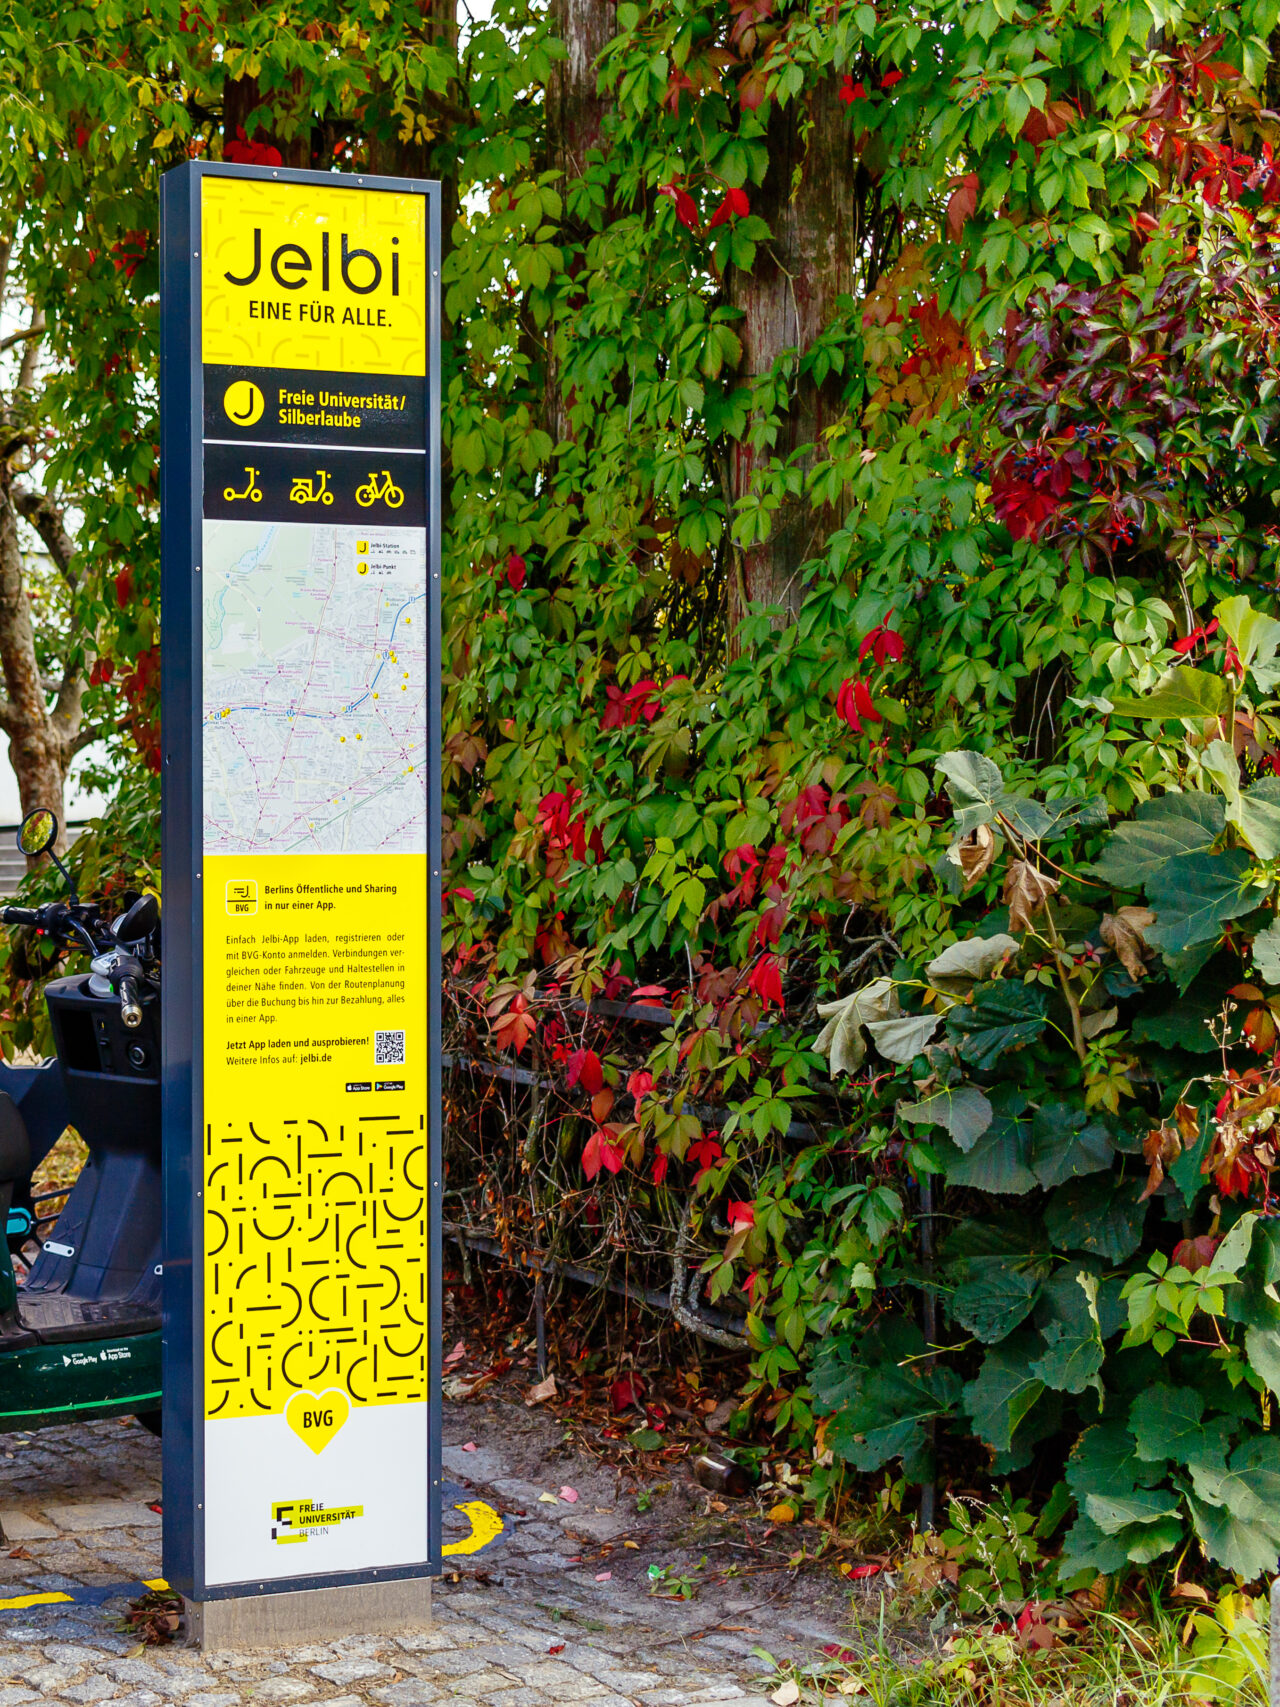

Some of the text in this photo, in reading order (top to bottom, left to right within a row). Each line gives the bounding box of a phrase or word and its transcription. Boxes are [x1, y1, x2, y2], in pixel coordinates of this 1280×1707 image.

[224, 228, 400, 296] Jelbi
[250, 300, 392, 328] EINE FÜR ALLE.
[279, 388, 406, 410] Freie Universität/
[278, 408, 361, 428] Silberlaube
[264, 884, 398, 896] Berlins Öffentliche und Sharing
[236, 904, 249, 912] BVG
[264, 900, 272, 910] in
[292, 900, 314, 910] einer
[316, 900, 336, 912] App.
[226, 932, 404, 944] Einfach Jelbi-App laden, registrieren oder
[242, 950, 286, 960] BVG-Konto
[288, 950, 330, 958] anmelden.
[332, 948, 388, 960] Verbindungen
[226, 966, 260, 978] gleichen
[264, 966, 282, 974] oder
[284, 966, 326, 976] Fahrzeuge
[328, 964, 344, 974] und
[348, 964, 394, 972] Haltestellen
[226, 980, 404, 992] deiner Nähe finden. Von der Routenplanung
[226, 998, 244, 1008] über
[246, 998, 258, 1006] die
[262, 998, 296, 1008] Buchung
[298, 996, 310, 1006] bis
[312, 996, 324, 1004] hin
[340, 994, 384, 1006] Bezahlung,
[386, 994, 406, 1004] alles
[226, 1014, 278, 1024] in einer App.
[226, 1036, 370, 1050] Jetzt App laden und ausprobieren!
[226, 1052, 332, 1066] Weitere Infos auf: jelbi.de
[304, 1410, 333, 1428] BVG
[299, 1502, 324, 1513] FREIE
[299, 1510, 356, 1524] UNIVERSITÄT
[299, 1526, 329, 1538] BERLIN
